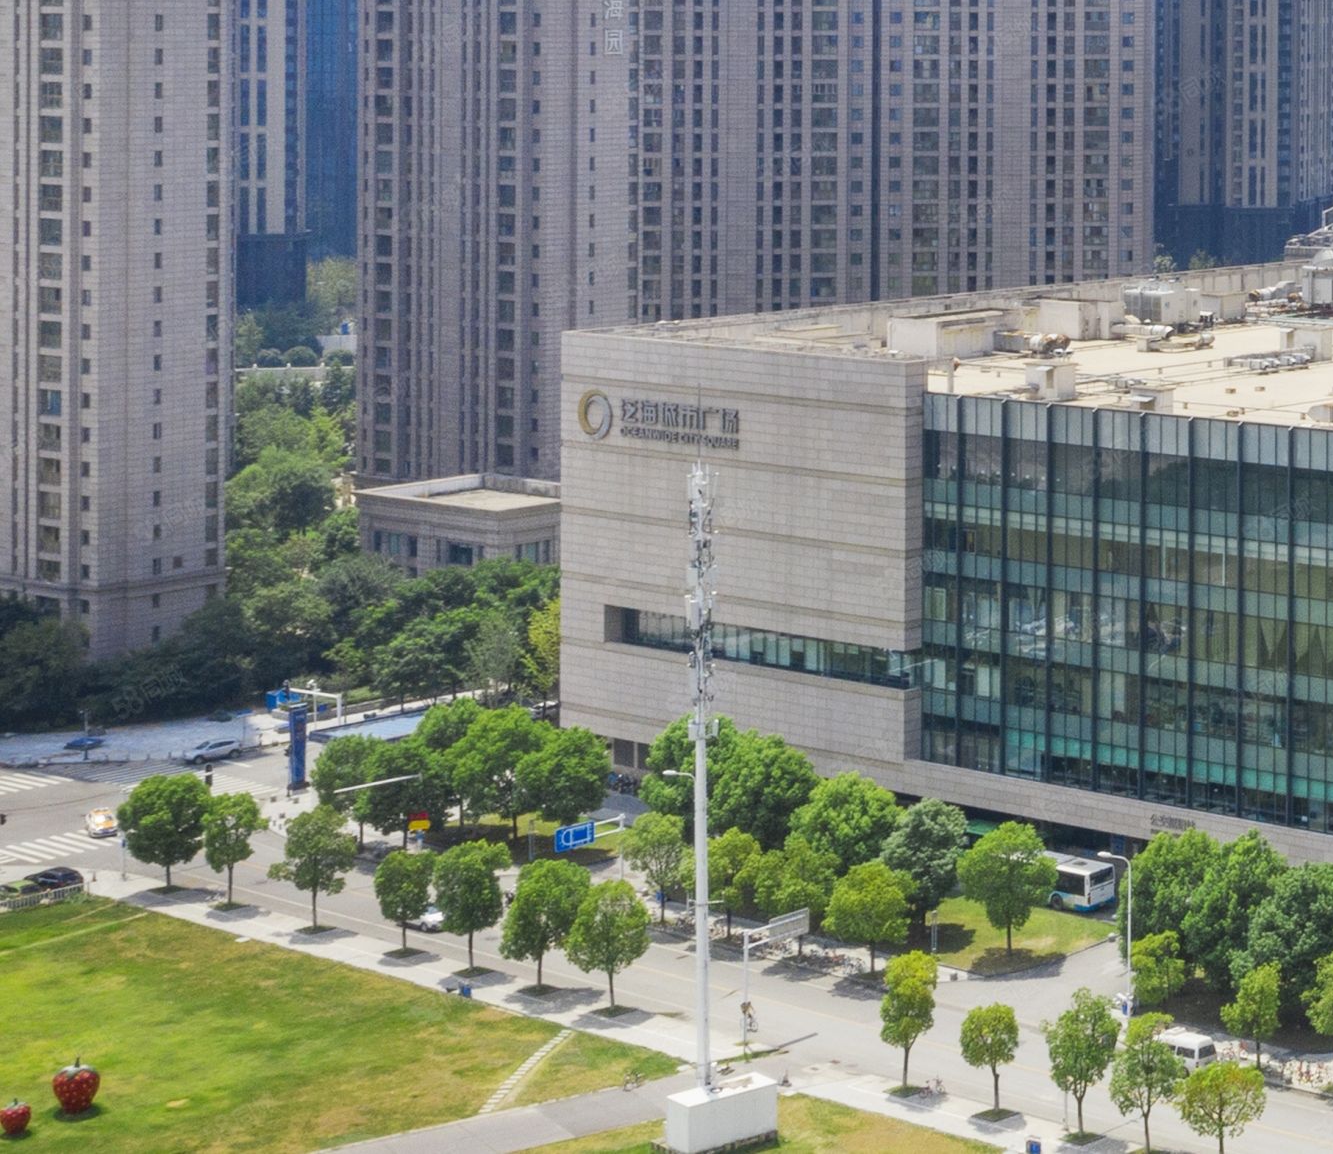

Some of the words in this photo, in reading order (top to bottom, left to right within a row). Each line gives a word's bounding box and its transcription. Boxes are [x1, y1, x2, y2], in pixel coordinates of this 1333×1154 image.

[621, 398, 740, 434] 泛海城市广场
[620, 426, 679, 443] OCEANWIDE
